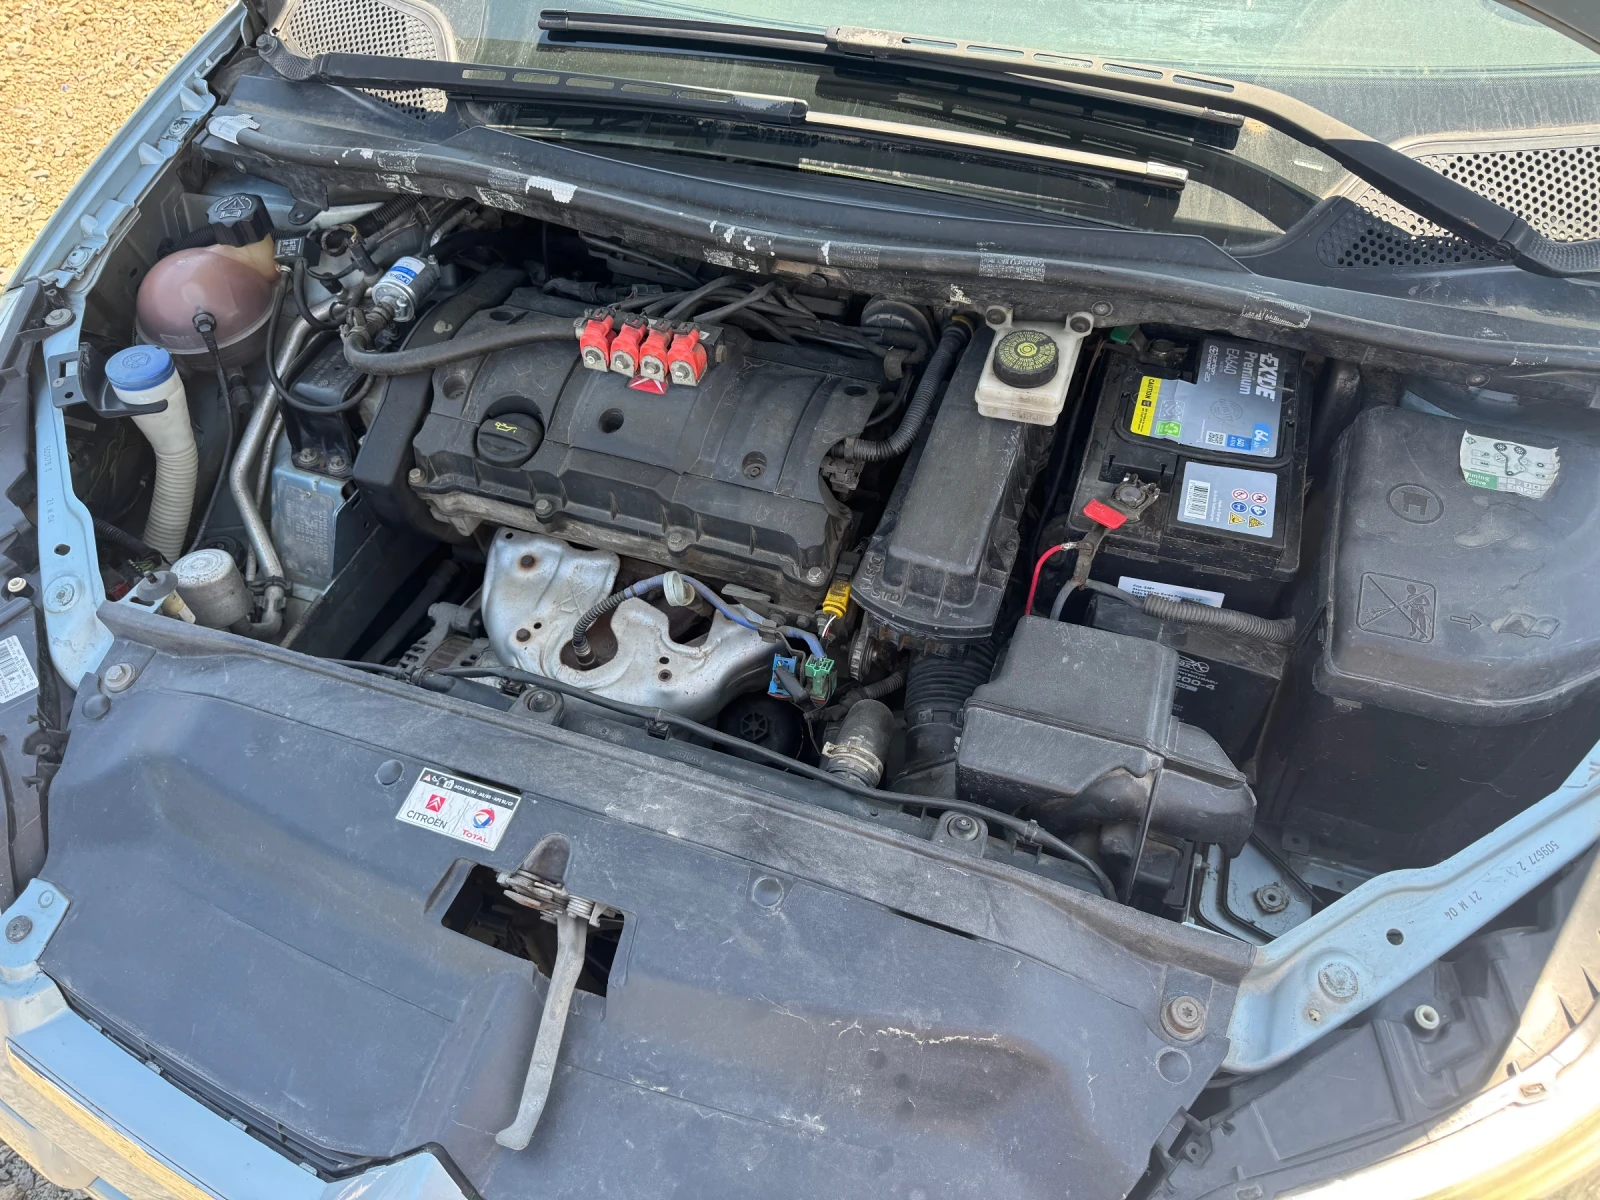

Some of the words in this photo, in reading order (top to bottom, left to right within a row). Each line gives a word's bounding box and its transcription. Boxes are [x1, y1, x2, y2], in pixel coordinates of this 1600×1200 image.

[1225, 347, 1240, 375] EA640
[1239, 351, 1258, 395] Premium
[1256, 353, 1279, 402] EXIDE
[1145, 378, 1155, 400] CAUTION
[1254, 429, 1269, 442] 64
[1467, 476, 1487, 486] Drive
[1468, 472, 1490, 483] iming
[406, 810, 448, 830] CITROËN
[462, 828, 489, 844] TOTAL
[1528, 840, 1560, 865] 509677
[1516, 861, 1527, 871] 2
[1468, 890, 1483, 904] 21
[1457, 900, 1469, 911] M
[1444, 907, 1459, 920] 04
